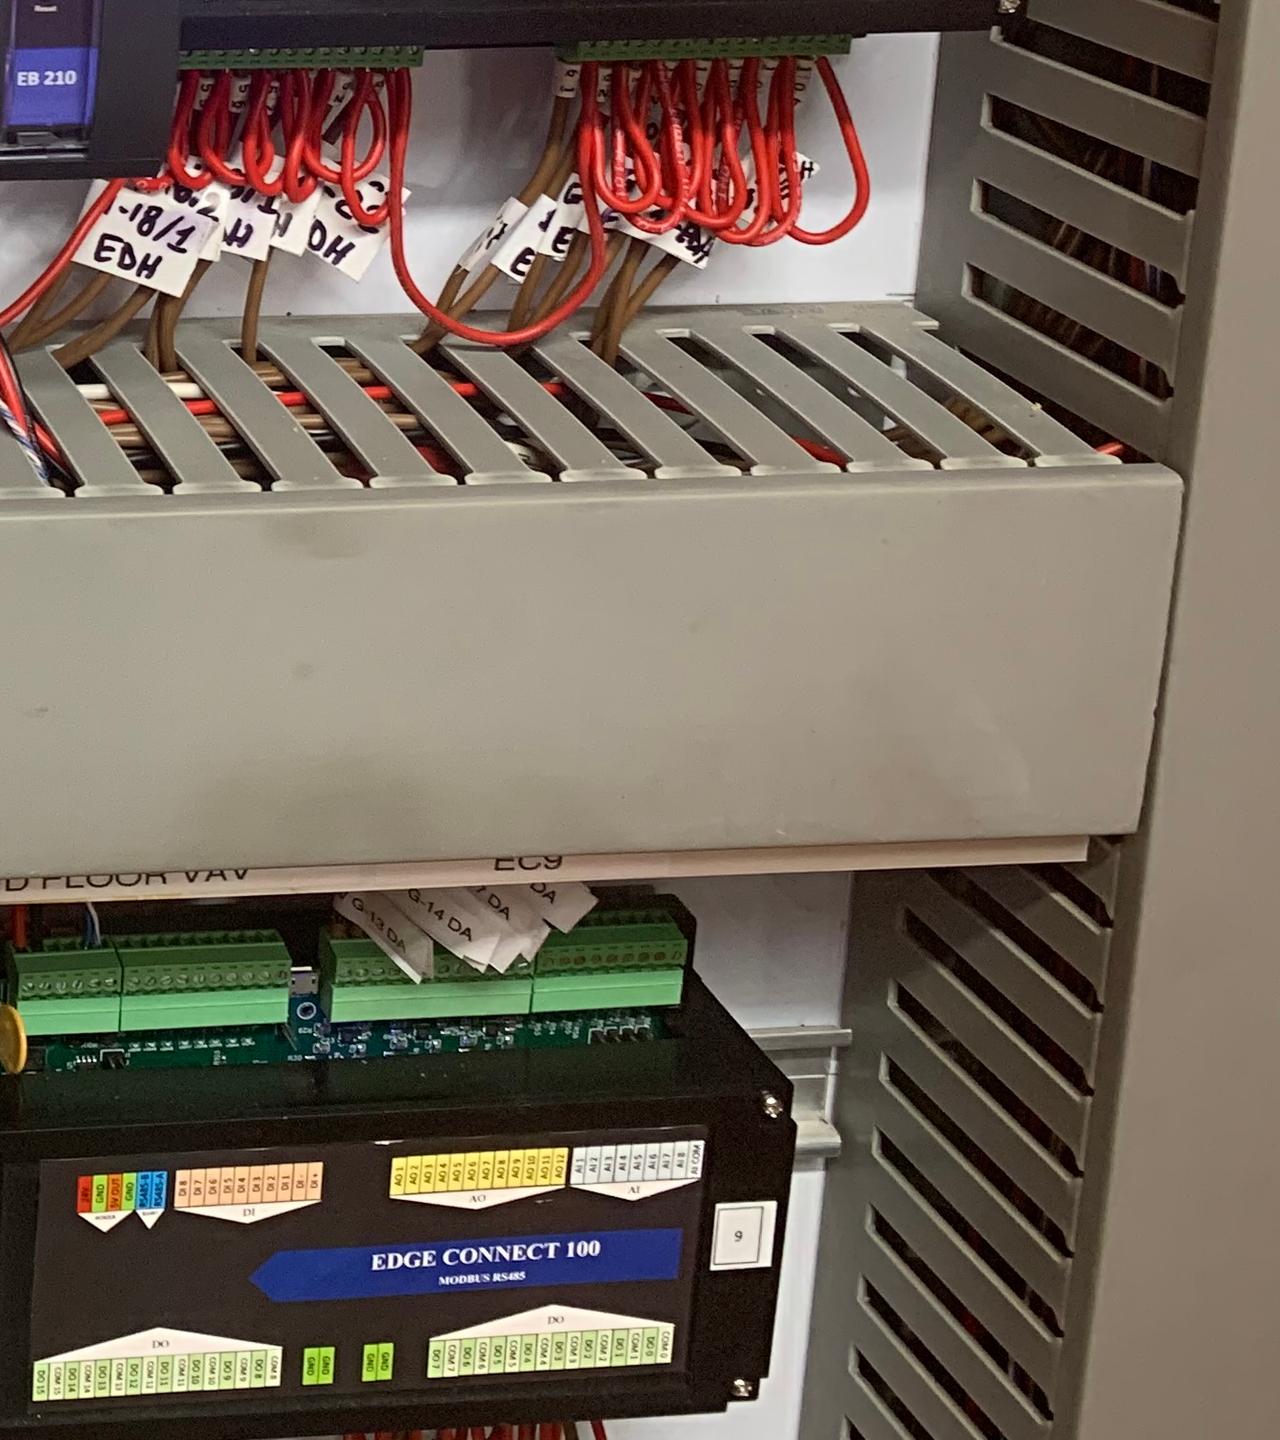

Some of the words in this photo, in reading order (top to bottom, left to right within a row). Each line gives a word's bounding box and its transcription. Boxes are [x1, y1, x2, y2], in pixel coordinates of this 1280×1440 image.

[18, 72, 39, 86] EB
[44, 71, 76, 85] 210
[94, 233, 163, 280] EDH
[530, 883, 556, 904] DA
[407, 887, 444, 922] G-14
[449, 916, 474, 942] DA
[487, 893, 511, 921] DA
[386, 928, 407, 954] DA
[243, 1208, 255, 1216] DI
[372, 1251, 436, 1270] EDGE
[443, 1243, 560, 1265] CONNECT
[568, 1241, 600, 1257] 100
[439, 1274, 490, 1285] MODBUS
[493, 1271, 525, 1281] RS485
[548, 1316, 564, 1324] DO
